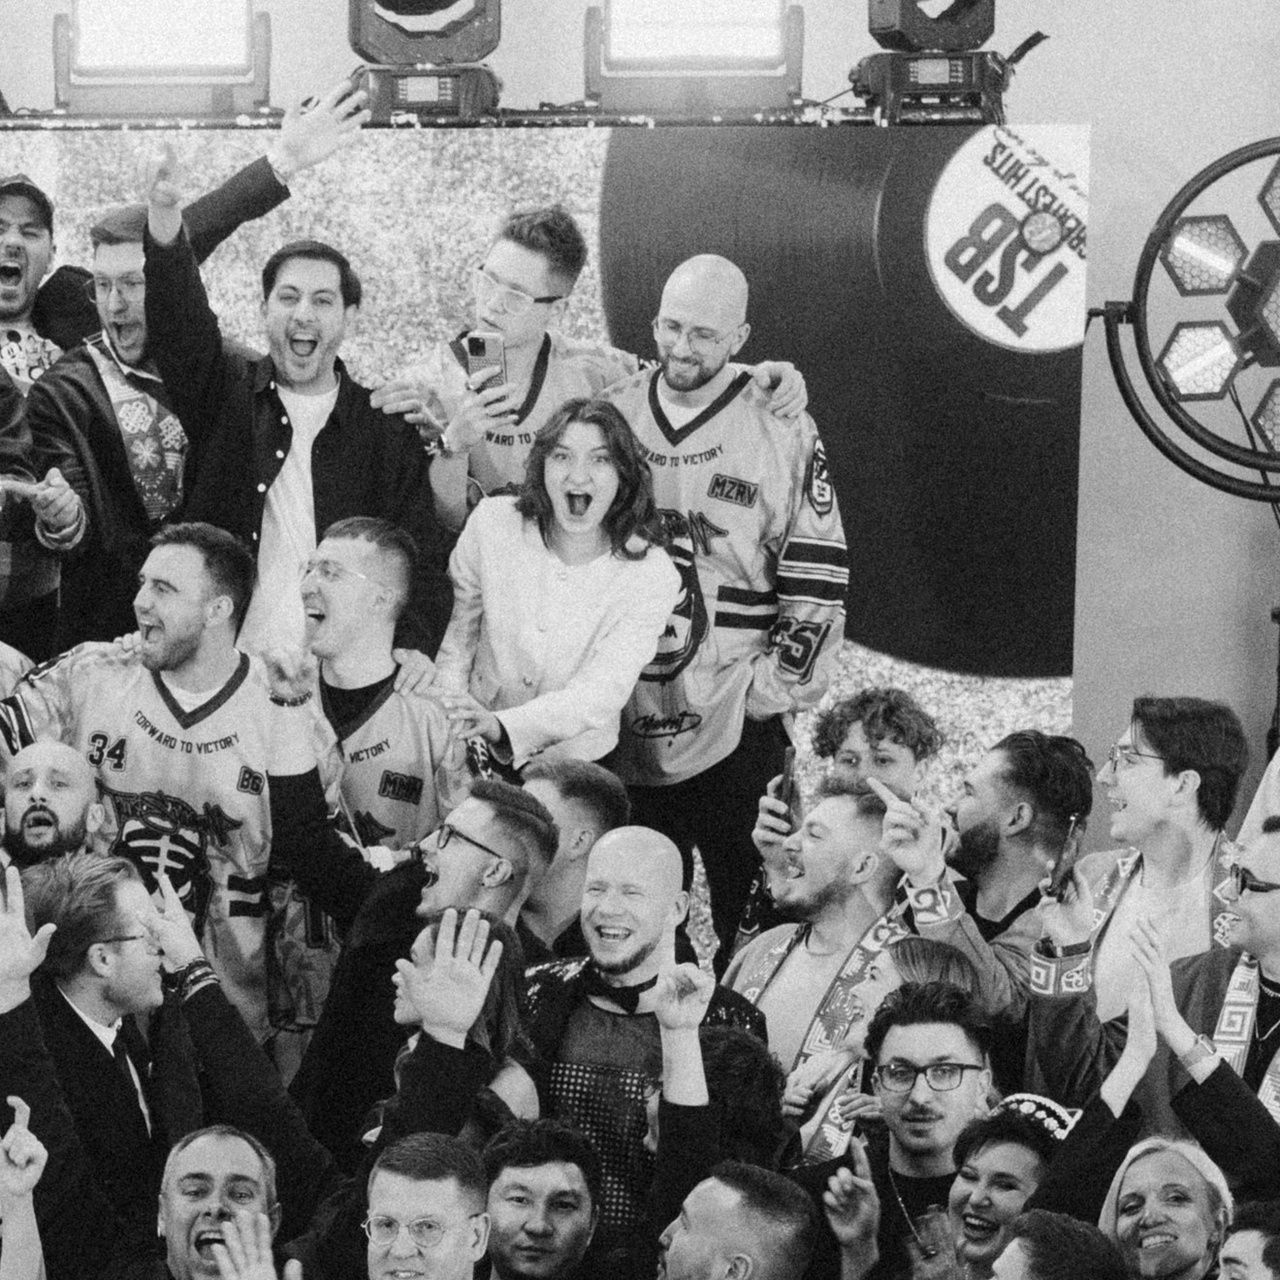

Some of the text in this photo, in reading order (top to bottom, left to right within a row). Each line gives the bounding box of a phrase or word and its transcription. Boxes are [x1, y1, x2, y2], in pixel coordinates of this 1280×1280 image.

[983, 142, 1031, 191] HITS
[944, 203, 1069, 338] TSB
[486, 430, 515, 447] WARD
[518, 433, 532, 445] TO
[670, 456, 680, 468] TO
[682, 443, 724, 466] VICTORY
[708, 474, 758, 508] MZRV
[134, 710, 240, 755] FORWARD TO VICTORY
[88, 732, 127, 771] 34
[349, 738, 391, 764] VICTORY
